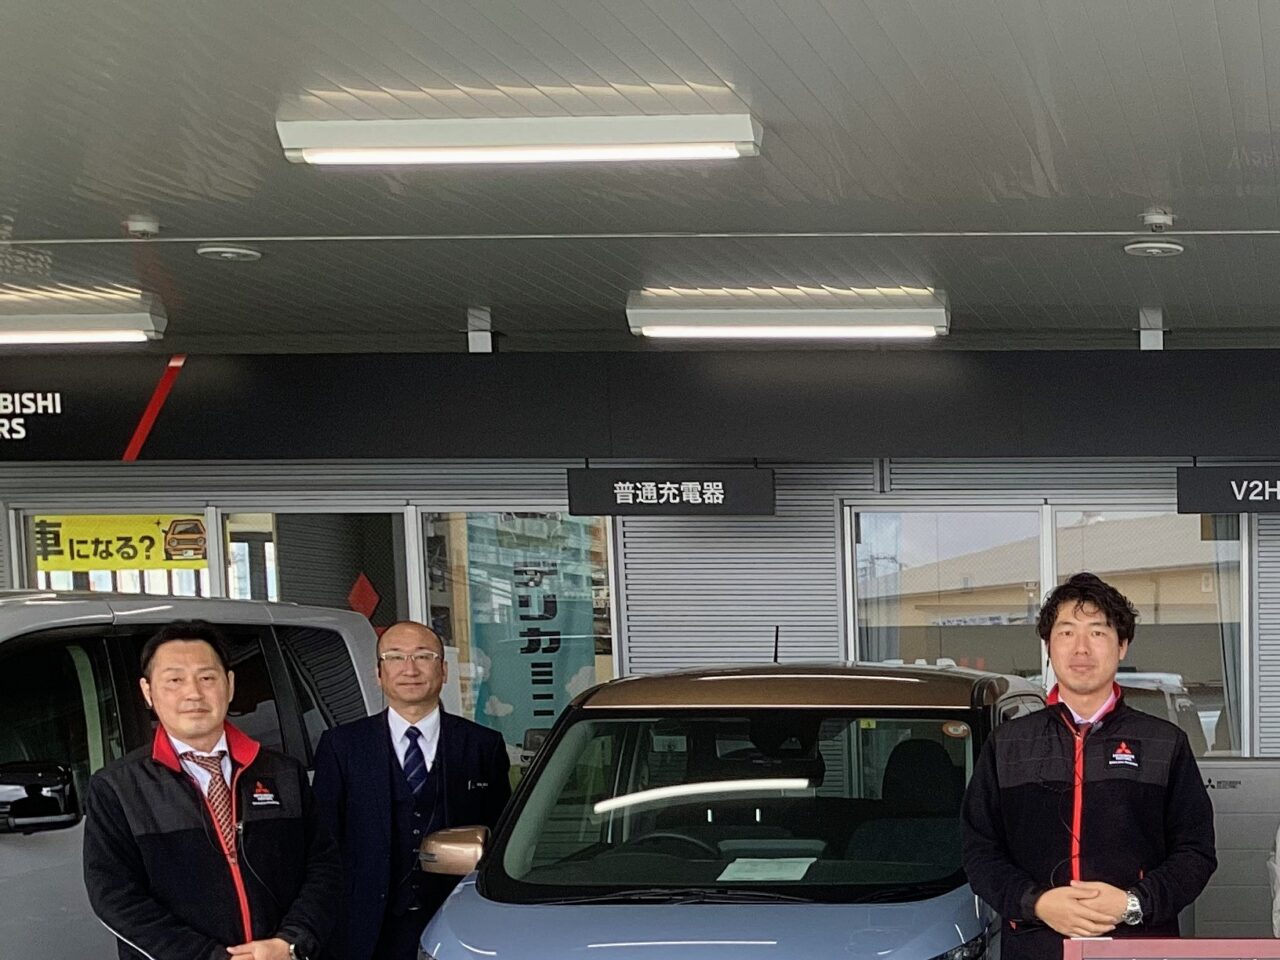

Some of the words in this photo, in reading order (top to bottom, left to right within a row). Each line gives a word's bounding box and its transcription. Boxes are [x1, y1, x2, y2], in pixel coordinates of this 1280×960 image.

[613, 481, 725, 504] 普通充電器
